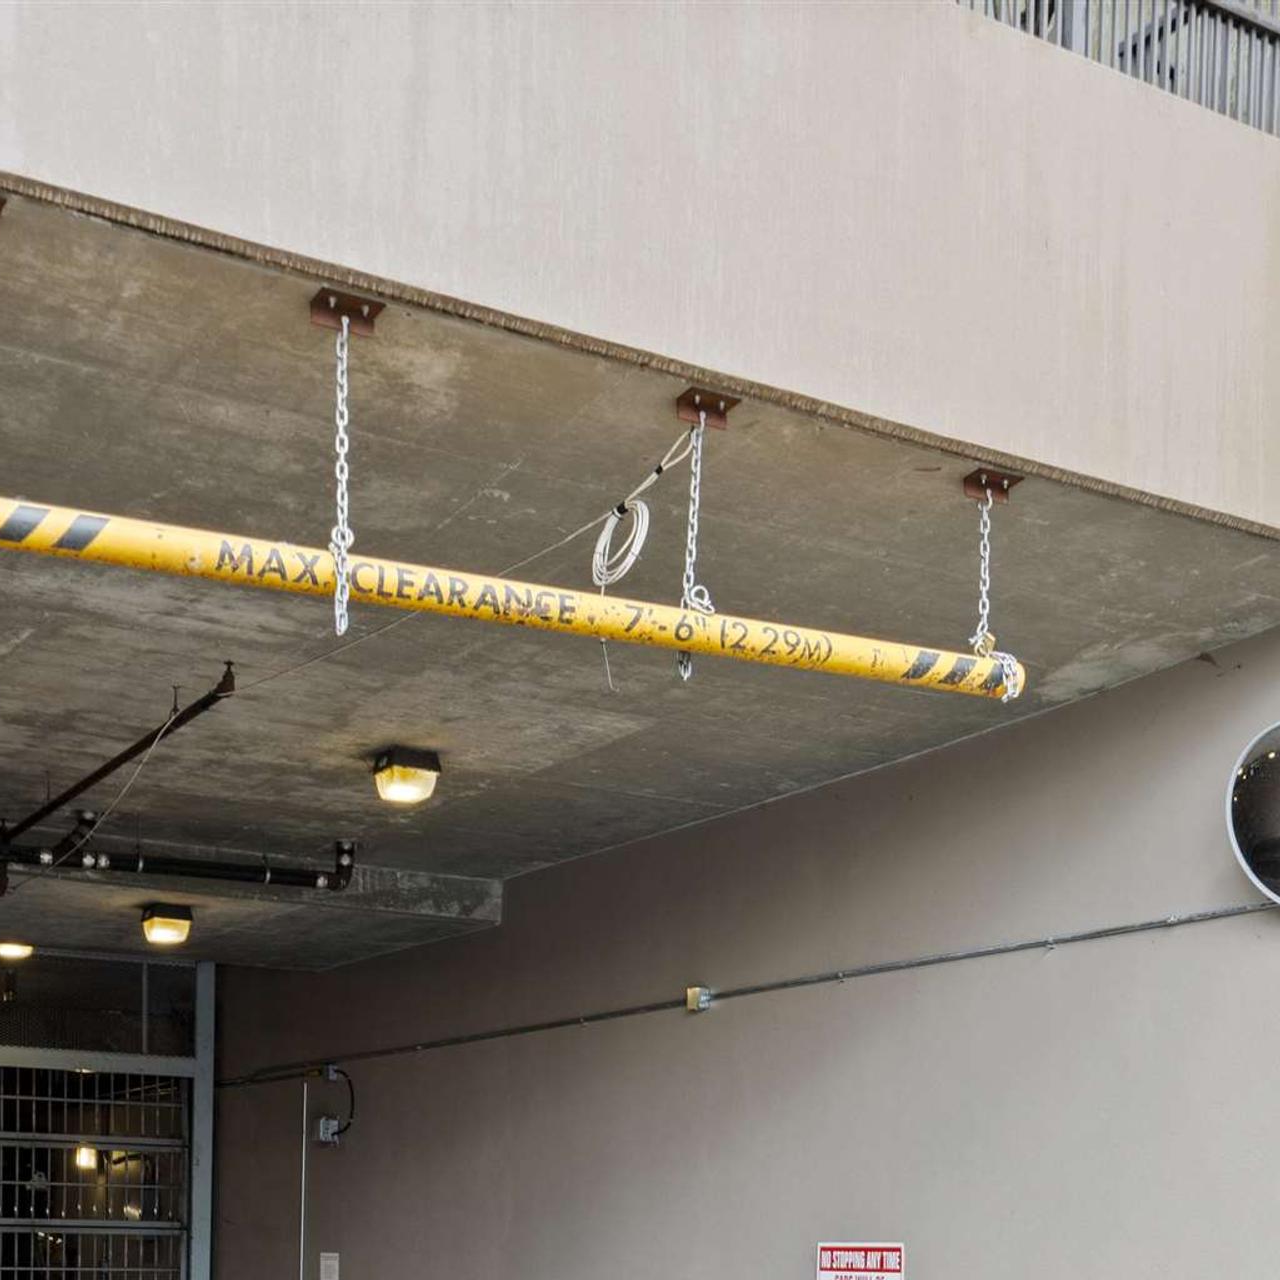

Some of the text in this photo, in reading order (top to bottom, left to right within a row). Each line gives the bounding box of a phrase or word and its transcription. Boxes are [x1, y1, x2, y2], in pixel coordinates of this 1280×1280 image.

[350, 562, 576, 624] CLEARANCE
[821, 1250, 900, 1270] NO STOPPING ANY TIME
